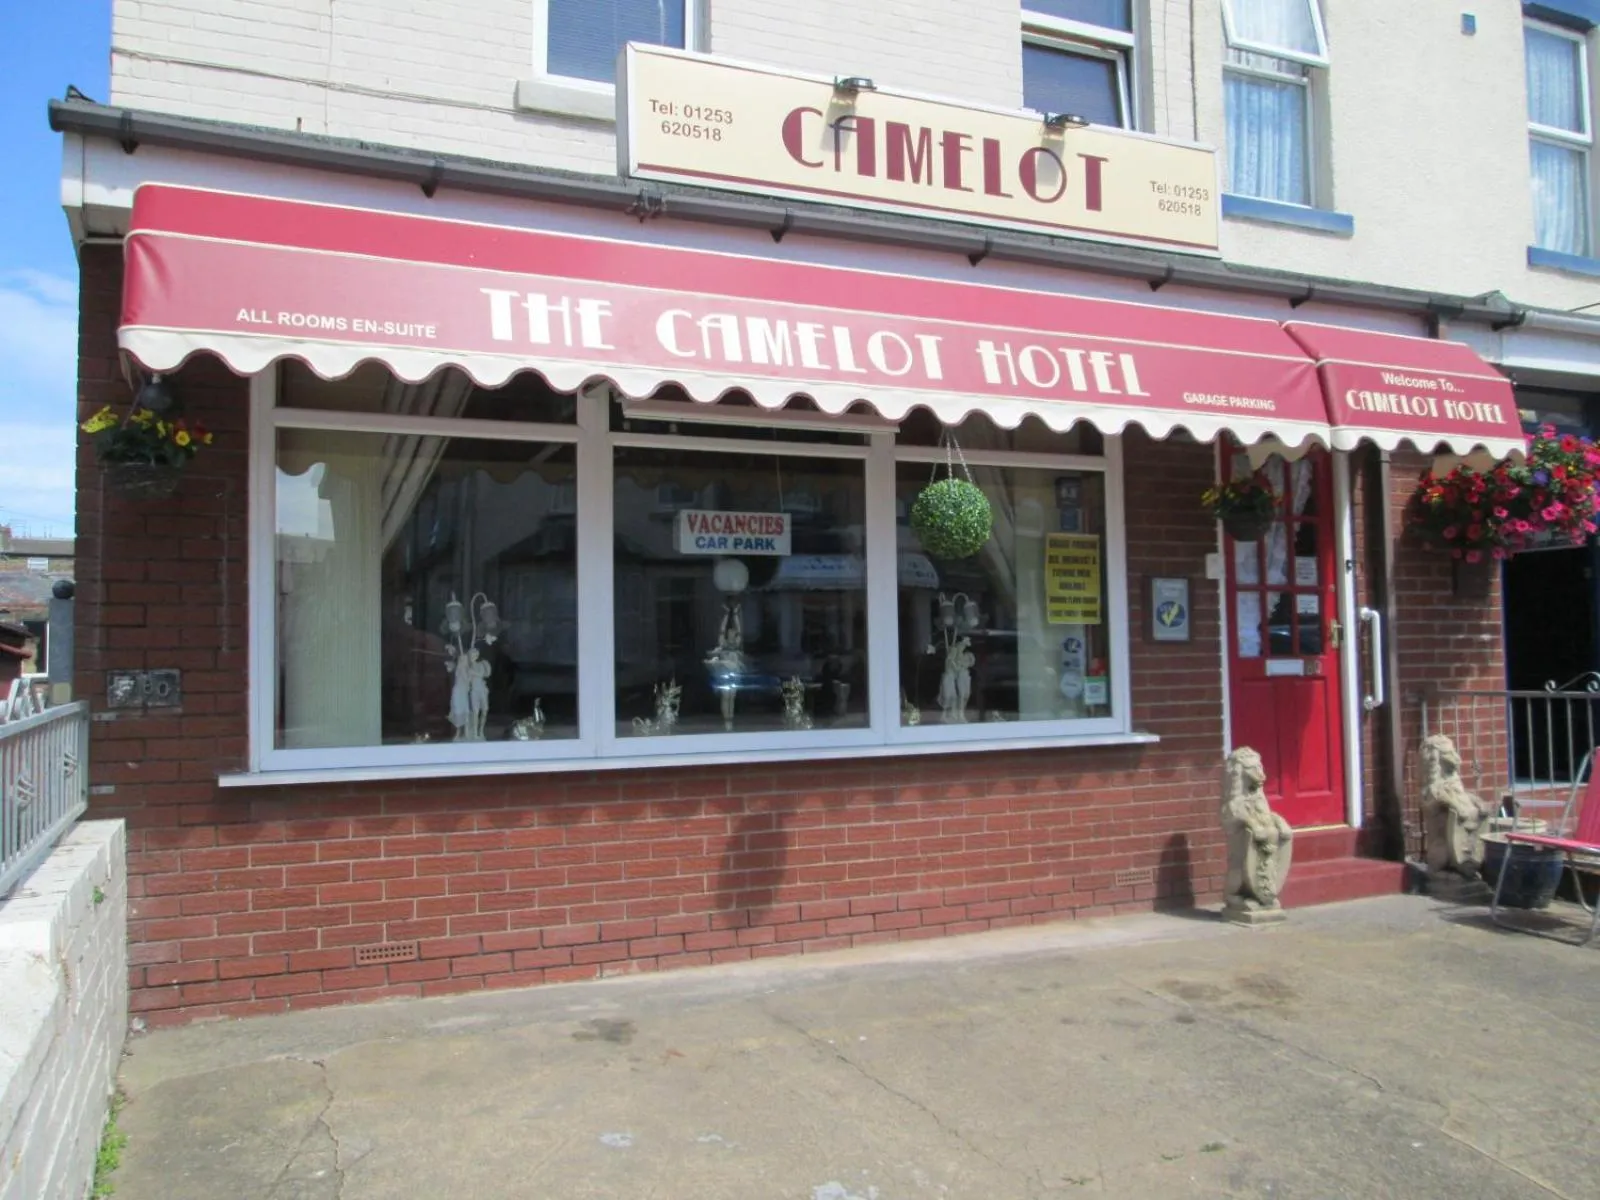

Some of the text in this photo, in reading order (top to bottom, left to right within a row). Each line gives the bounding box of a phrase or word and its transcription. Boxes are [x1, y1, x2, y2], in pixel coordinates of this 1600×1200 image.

[648, 98, 733, 125] Tel: 01253
[661, 120, 722, 142] 620518
[782, 106, 1109, 212] CAMELOT
[1149, 180, 1209, 201] Tel: 01253
[1158, 199, 1202, 216] 620518
[236, 308, 437, 339] ALL ROOMS EN-SUITE
[480, 287, 1150, 397] THE CAMELOT HOTEL
[1381, 371, 1437, 391] Welcome
[1183, 391, 1276, 412] GARAGE PARKING
[1345, 389, 1508, 425] CAMELOT HOTEL
[686, 512, 785, 537] VACANCIES
[695, 535, 776, 551] CAR PARK
